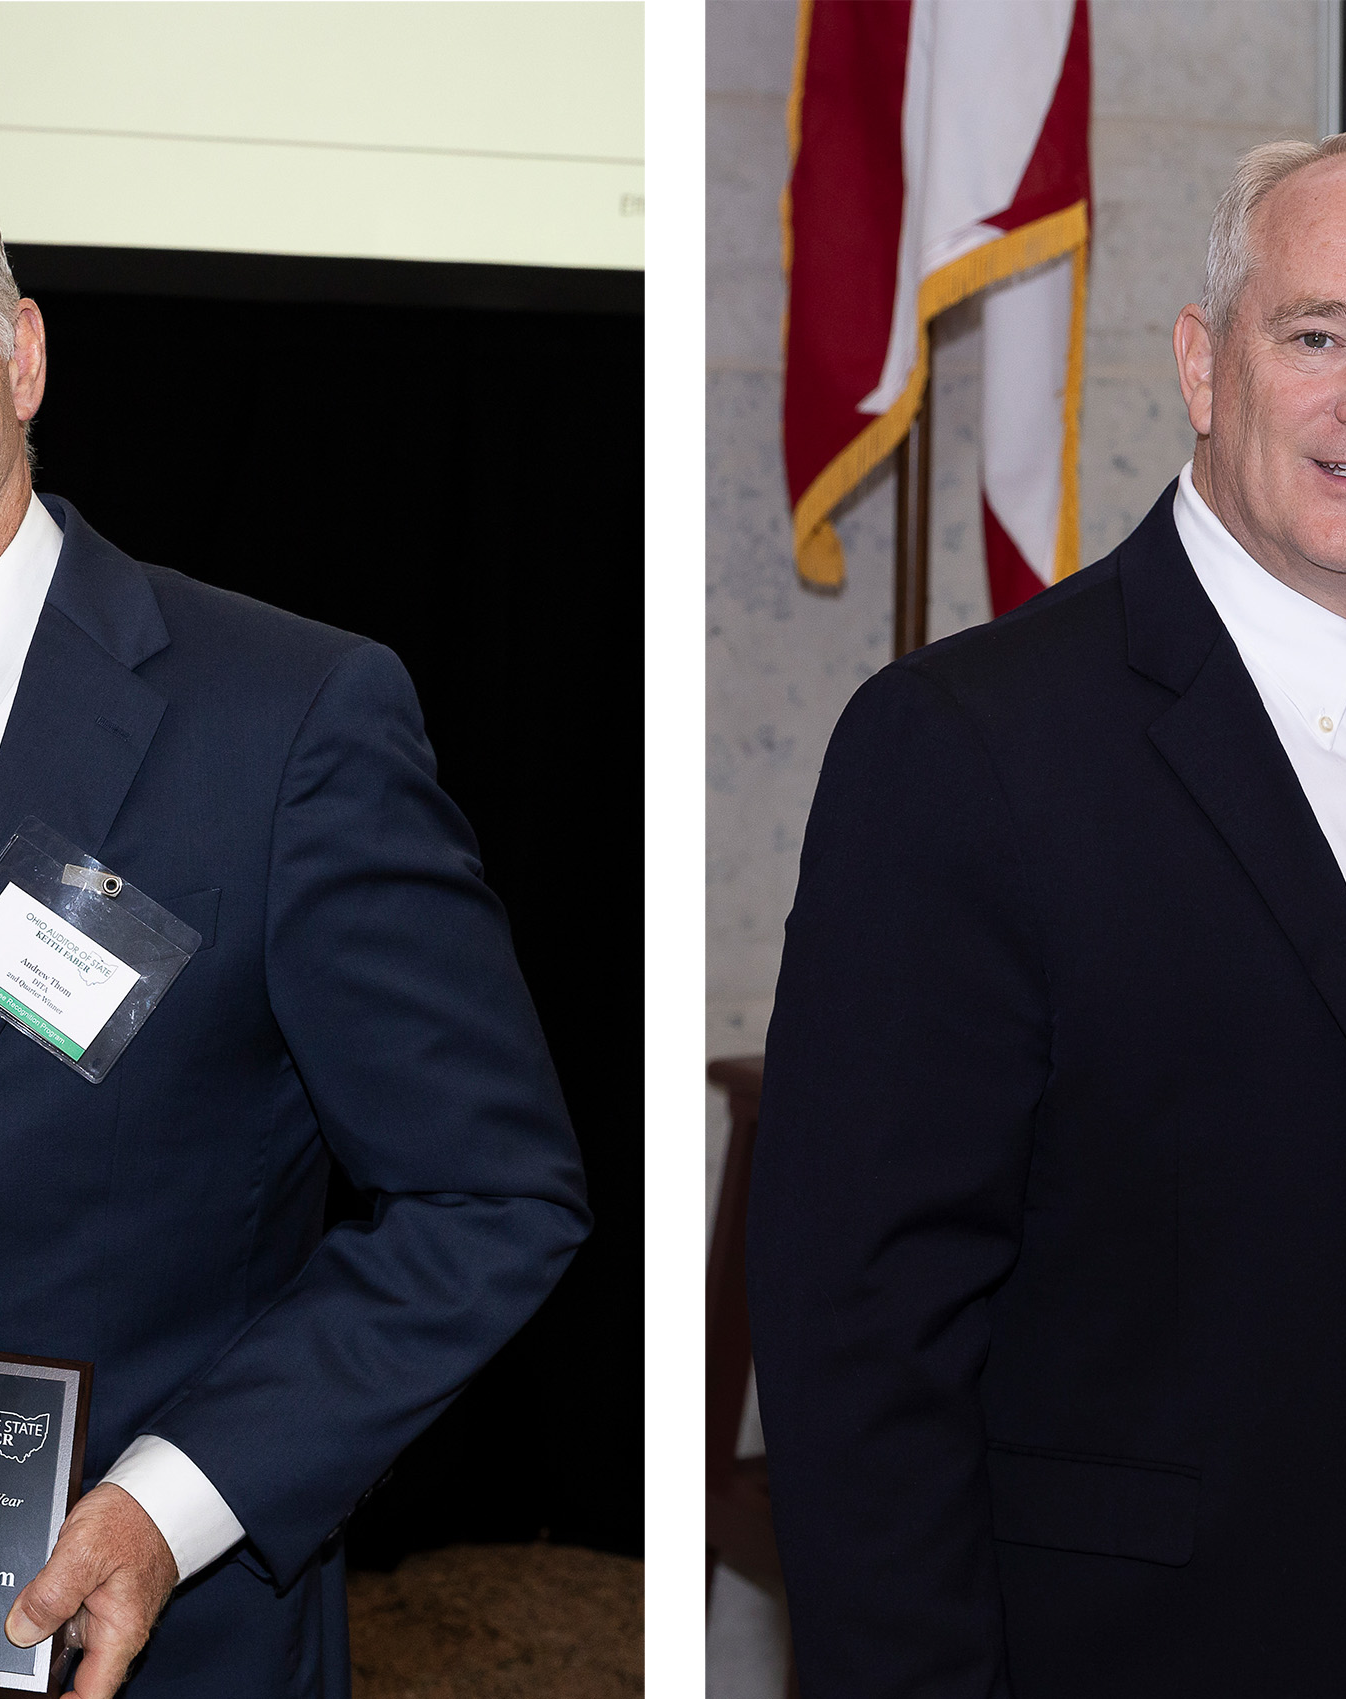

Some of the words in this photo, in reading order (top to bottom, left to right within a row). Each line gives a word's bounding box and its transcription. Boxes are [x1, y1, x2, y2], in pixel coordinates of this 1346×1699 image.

[26, 913, 47, 930] OHIO
[47, 928, 80, 954] AUDITOR
[79, 951, 92, 961] OF
[90, 960, 112, 977] STATE
[35, 930, 64, 953] KEITH
[63, 950, 90, 973] FABER
[6, 971, 20, 983] 2nd
[18, 979, 42, 999] Quarter
[41, 996, 63, 1015] Winner
[20, 958, 50, 980] Andrew
[50, 977, 72, 998] Thom
[32, 978, 49, 993] DITA
[6, 998, 40, 1026] Recognition
[39, 1022, 65, 1045] Program
[4, 1420, 43, 1437] STATE
